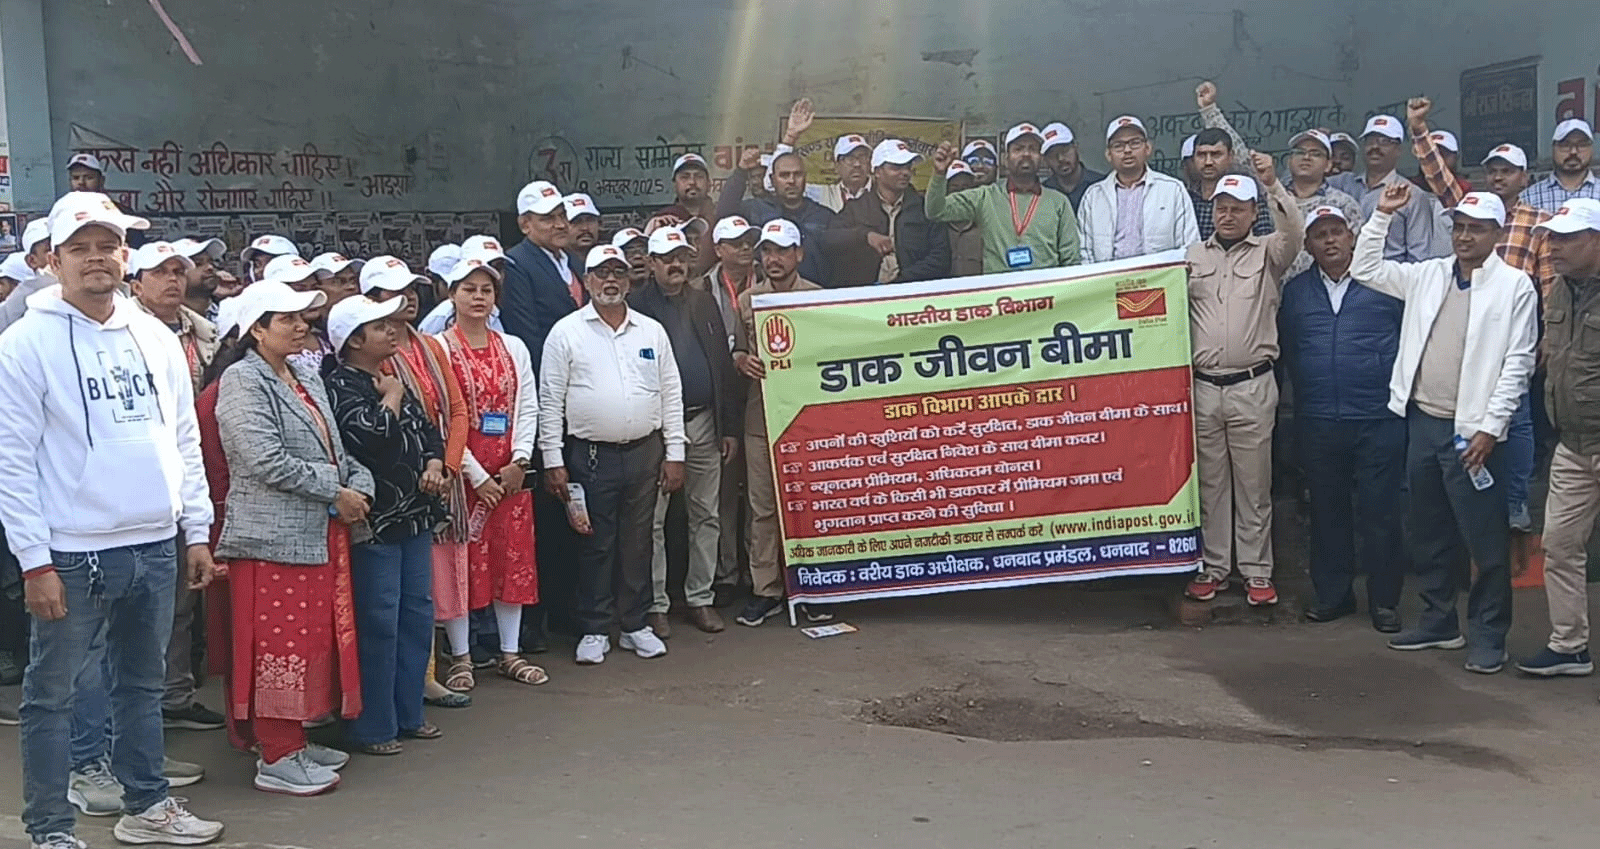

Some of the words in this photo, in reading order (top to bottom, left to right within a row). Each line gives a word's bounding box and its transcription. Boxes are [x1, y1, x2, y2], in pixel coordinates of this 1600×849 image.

[141, 140, 184, 179] नहीं
[188, 141, 276, 177] अधिकार
[585, 146, 624, 171] राज्य
[145, 179, 185, 211] और
[197, 180, 258, 209] रोजगार
[887, 305, 952, 327] भारतीय
[954, 304, 993, 322] डाक
[996, 296, 1055, 316] विभाग
[770, 359, 792, 370] PLI
[817, 353, 904, 393] डाक
[910, 335, 1033, 378] जीवन
[1038, 322, 1133, 365] बीमा
[884, 401, 918, 420] डाक
[922, 396, 973, 416] विभाग
[978, 388, 1031, 411] आपके
[1036, 385, 1064, 404] द्वार
[806, 434, 845, 452] अपनों
[847, 432, 867, 447] की
[869, 426, 918, 448] खुशियों
[920, 425, 940, 440] को
[942, 422, 967, 437] करें
[1025, 416, 1054, 430] डाक
[1057, 411, 1096, 426] जीवन
[1099, 406, 1131, 421] बीमा
[1134, 404, 1149, 417] के
[808, 453, 864, 472] आकर्षक
[867, 450, 887, 465] एवं
[889, 448, 938, 467] सुरक्षित
[940, 443, 979, 459] निवेश
[982, 441, 997, 455] के
[1000, 441, 1029, 453] साथ
[1031, 436, 1063, 450] बीमा
[810, 478, 862, 495] न्यूनतम
[926, 464, 992, 482] अधिकतम
[812, 498, 847, 512] भारत
[850, 494, 870, 507] वर्ष
[873, 492, 888, 506] के
[890, 487, 927, 504] किसी
[929, 486, 946, 500] भी
[949, 482, 996, 498] डाकघर
[997, 478, 1010, 493] में
[1014, 474, 1068, 494] प्रीमियम
[1070, 472, 1099, 485] जमा
[1102, 468, 1123, 484] एवं
[814, 515, 866, 533] भुगतान
[868, 512, 899, 526] प्राप्त
[902, 507, 936, 522] करने
[939, 505, 958, 519] की
[961, 501, 1004, 519] सुविधा
[816, 540, 855, 556] जानकारी
[857, 539, 867, 553] के
[869, 538, 887, 552] लिए
[889, 534, 912, 550] अपने
[953, 532, 983, 545] डाकघर
[985, 526, 994, 541] से
[996, 523, 1026, 540] सम्पर्क
[798, 567, 847, 587] निवेदक
[858, 561, 892, 582] वरीय
[895, 564, 924, 580] डाक
[993, 551, 1041, 569] धनबाद
[1100, 542, 1149, 560] धनबाद
